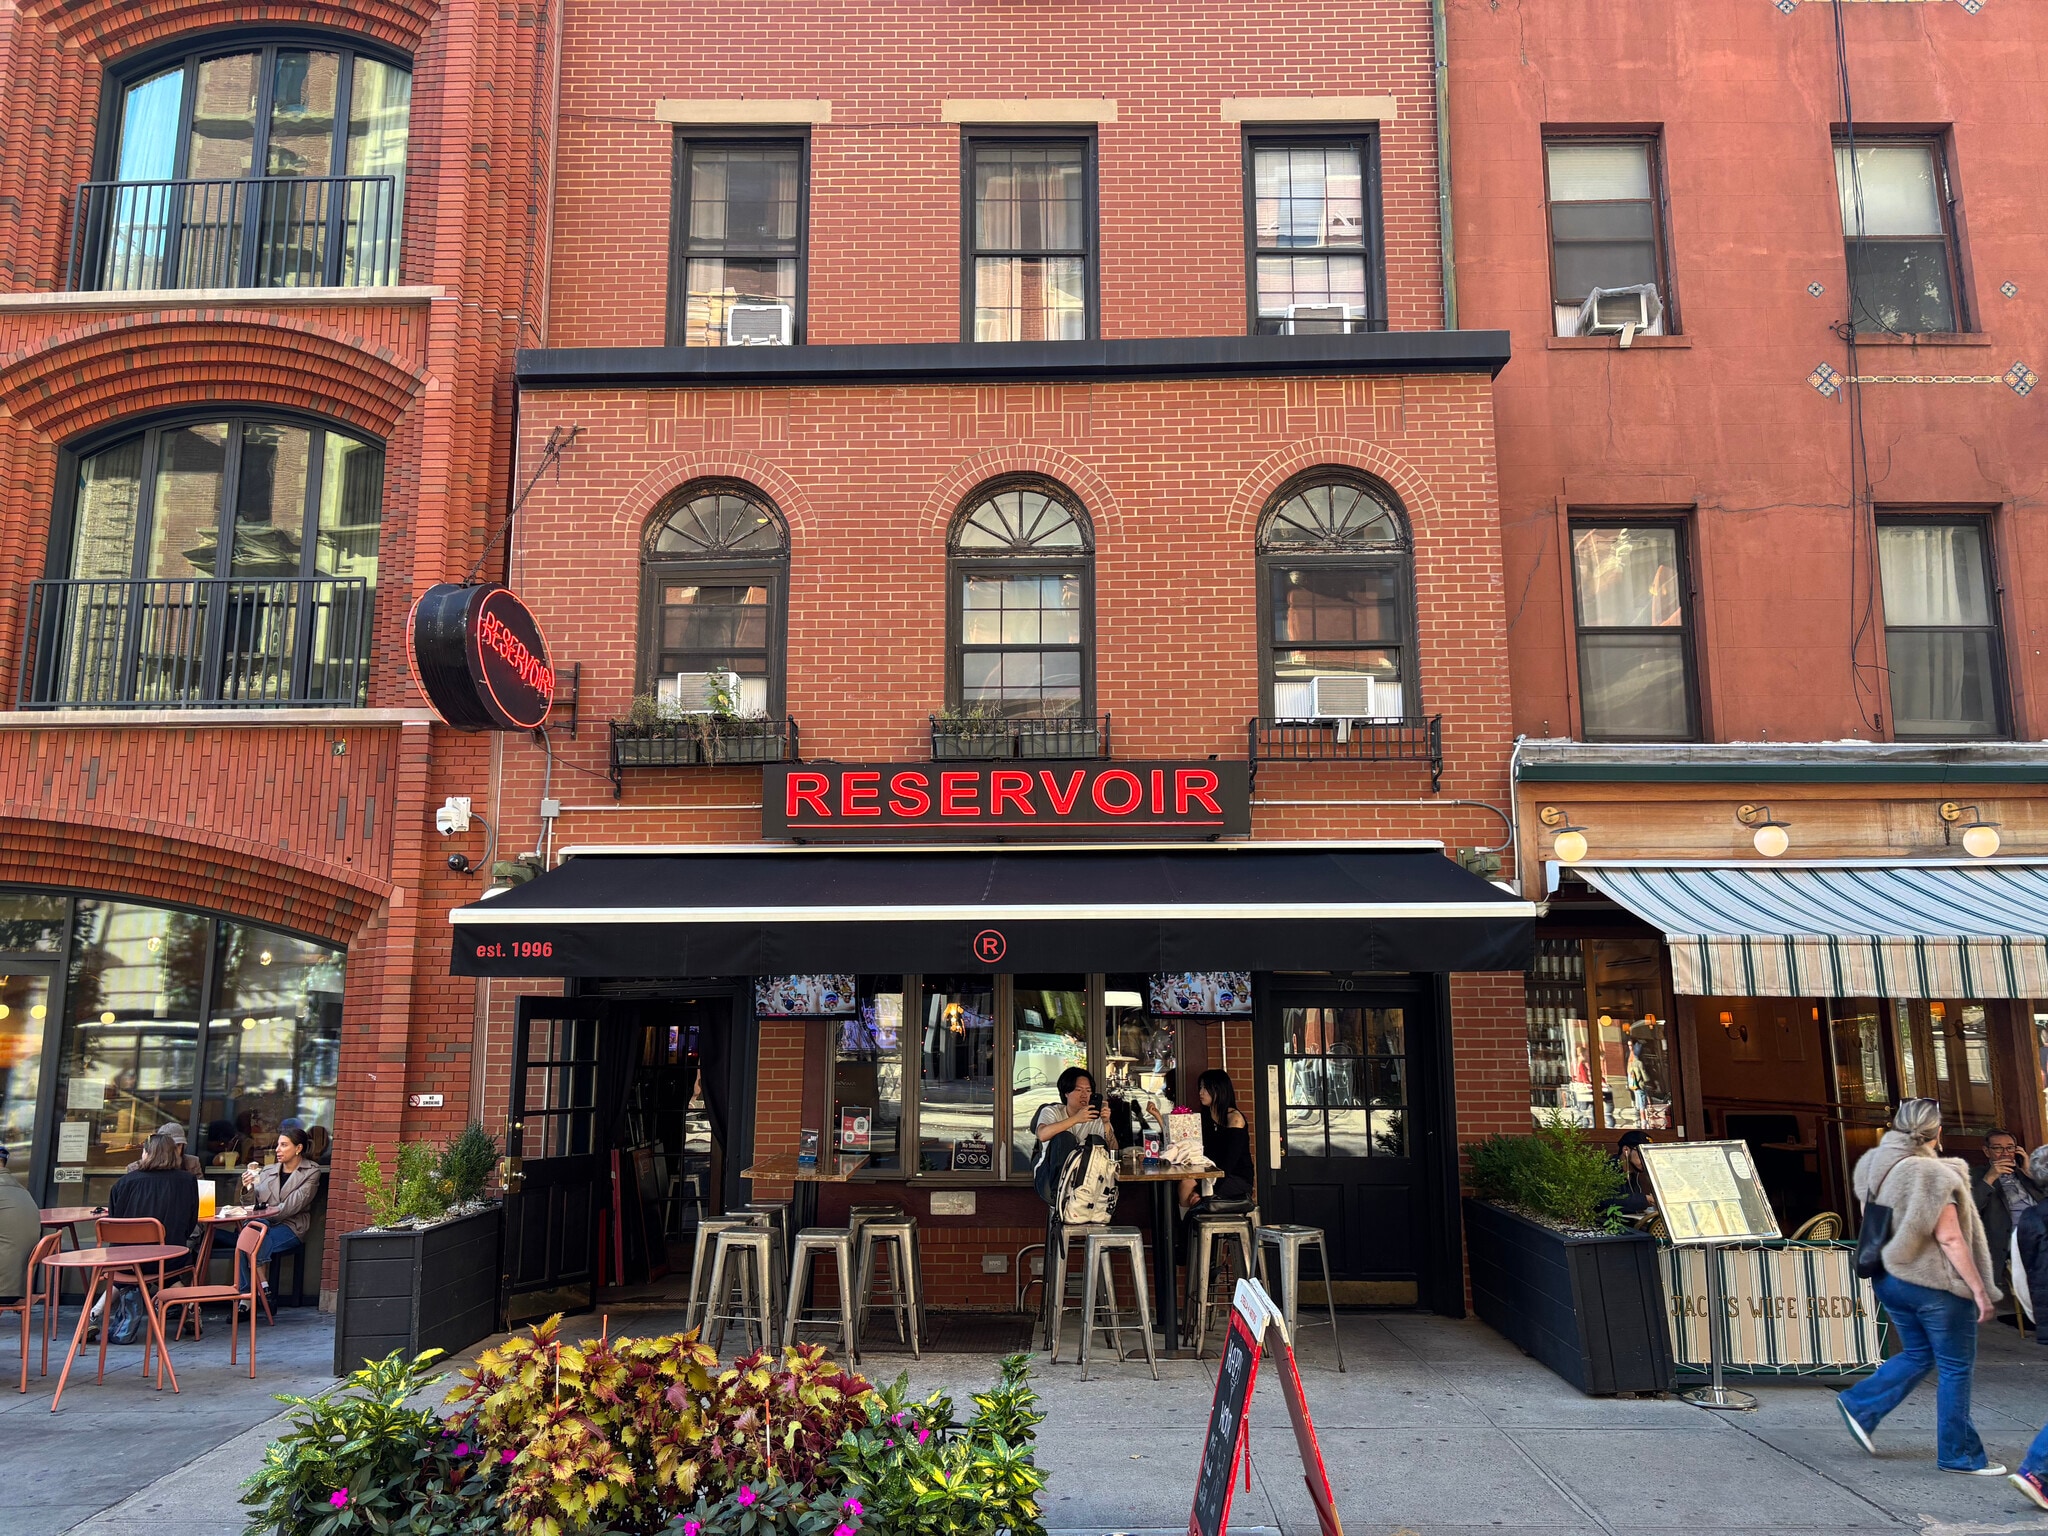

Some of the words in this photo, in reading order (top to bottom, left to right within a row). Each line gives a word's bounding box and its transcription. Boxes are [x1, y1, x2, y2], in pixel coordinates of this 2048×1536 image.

[482, 611, 551, 698] RESERVOIR
[785, 769, 1224, 818] RESERVOIR
[476, 942, 506, 957] est.
[512, 941, 553, 957] 1996
[982, 937, 999, 955] R
[1337, 979, 1354, 991] 70
[1671, 1295, 1740, 1319] JAC'S
[1747, 1296, 1798, 1319] WIFE
[1806, 1296, 1868, 1319] FREDA
